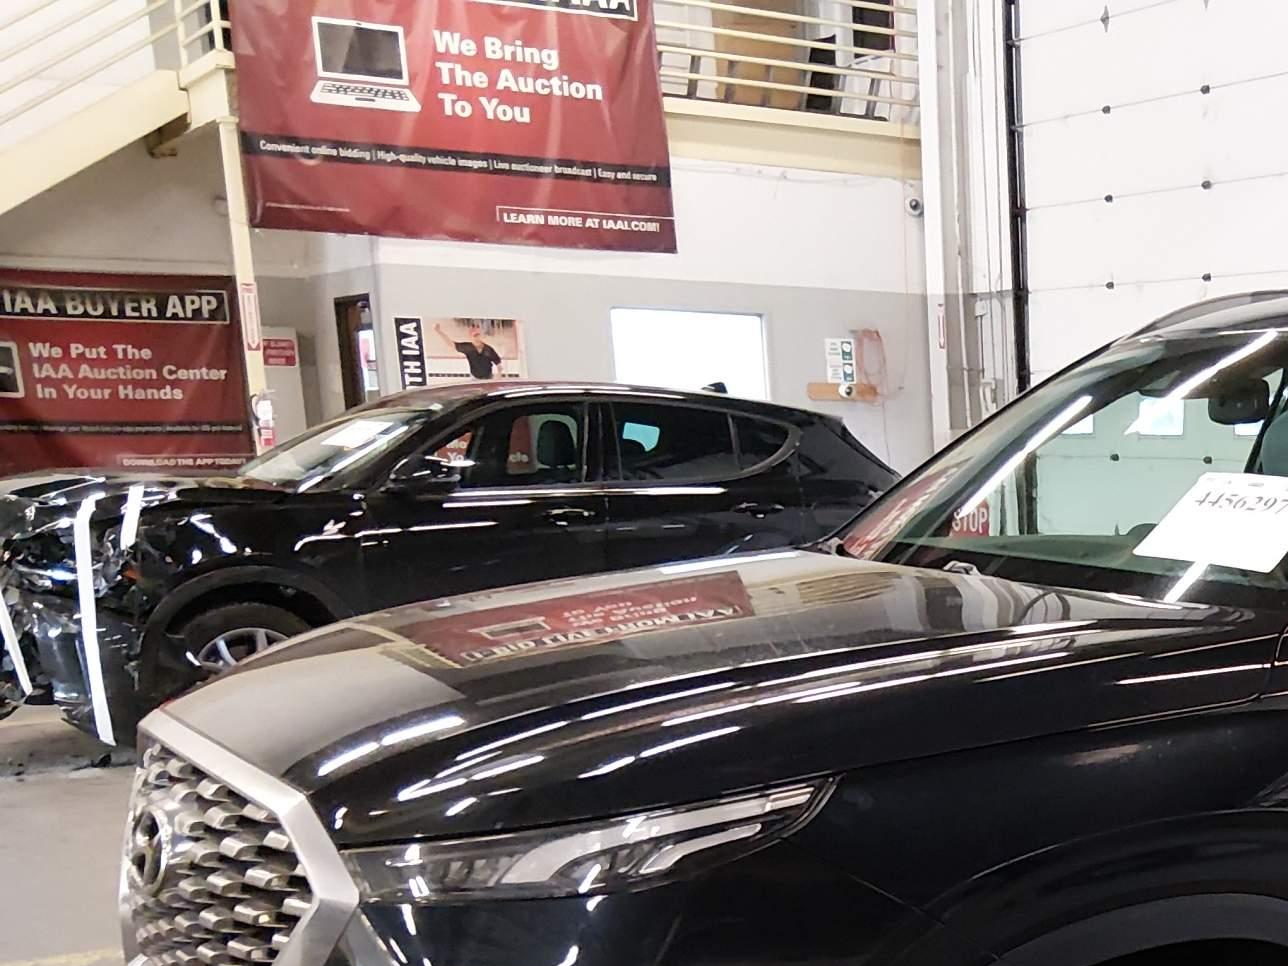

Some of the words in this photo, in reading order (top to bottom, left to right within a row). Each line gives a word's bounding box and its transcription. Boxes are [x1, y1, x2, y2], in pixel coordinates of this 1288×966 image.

[433, 29, 477, 56] We
[484, 36, 559, 71] Bring
[435, 61, 489, 88] The
[496, 69, 603, 101] Auction
[437, 92, 473, 118] To
[479, 96, 531, 123] You
[259, 140, 310, 154] Convenient
[311, 146, 338, 156] online
[339, 147, 371, 160] bidding
[377, 150, 426, 164] High-quality
[428, 155, 456, 166] vehicle
[458, 158, 487, 169] images
[494, 160, 509, 169] Live
[511, 162, 552, 173] auctioneer
[554, 164, 592, 176] broadcast
[598, 167, 615, 180] Easy
[616, 170, 631, 180] and
[632, 172, 657, 182] secure
[503, 212, 545, 225] LEARN
[547, 215, 583, 228] MORE
[585, 218, 601, 229] AT
[2, 289, 58, 315] IAA
[65, 292, 158, 319] BUYER
[166, 295, 218, 319] APP
[28, 341, 63, 359] We
[70, 342, 107, 360] Put
[112, 344, 153, 361] The
[399, 322, 420, 355] IAA
[33, 363, 76, 379] IAA
[79, 364, 158, 381] Auction
[162, 365, 228, 381] Center
[36, 384, 57, 399] In
[63, 384, 112, 400] Your
[118, 384, 185, 401] Hands
[122, 457, 176, 467] DOWNLOAD
[177, 457, 194, 466] THE
[952, 508, 988, 534] STOP
